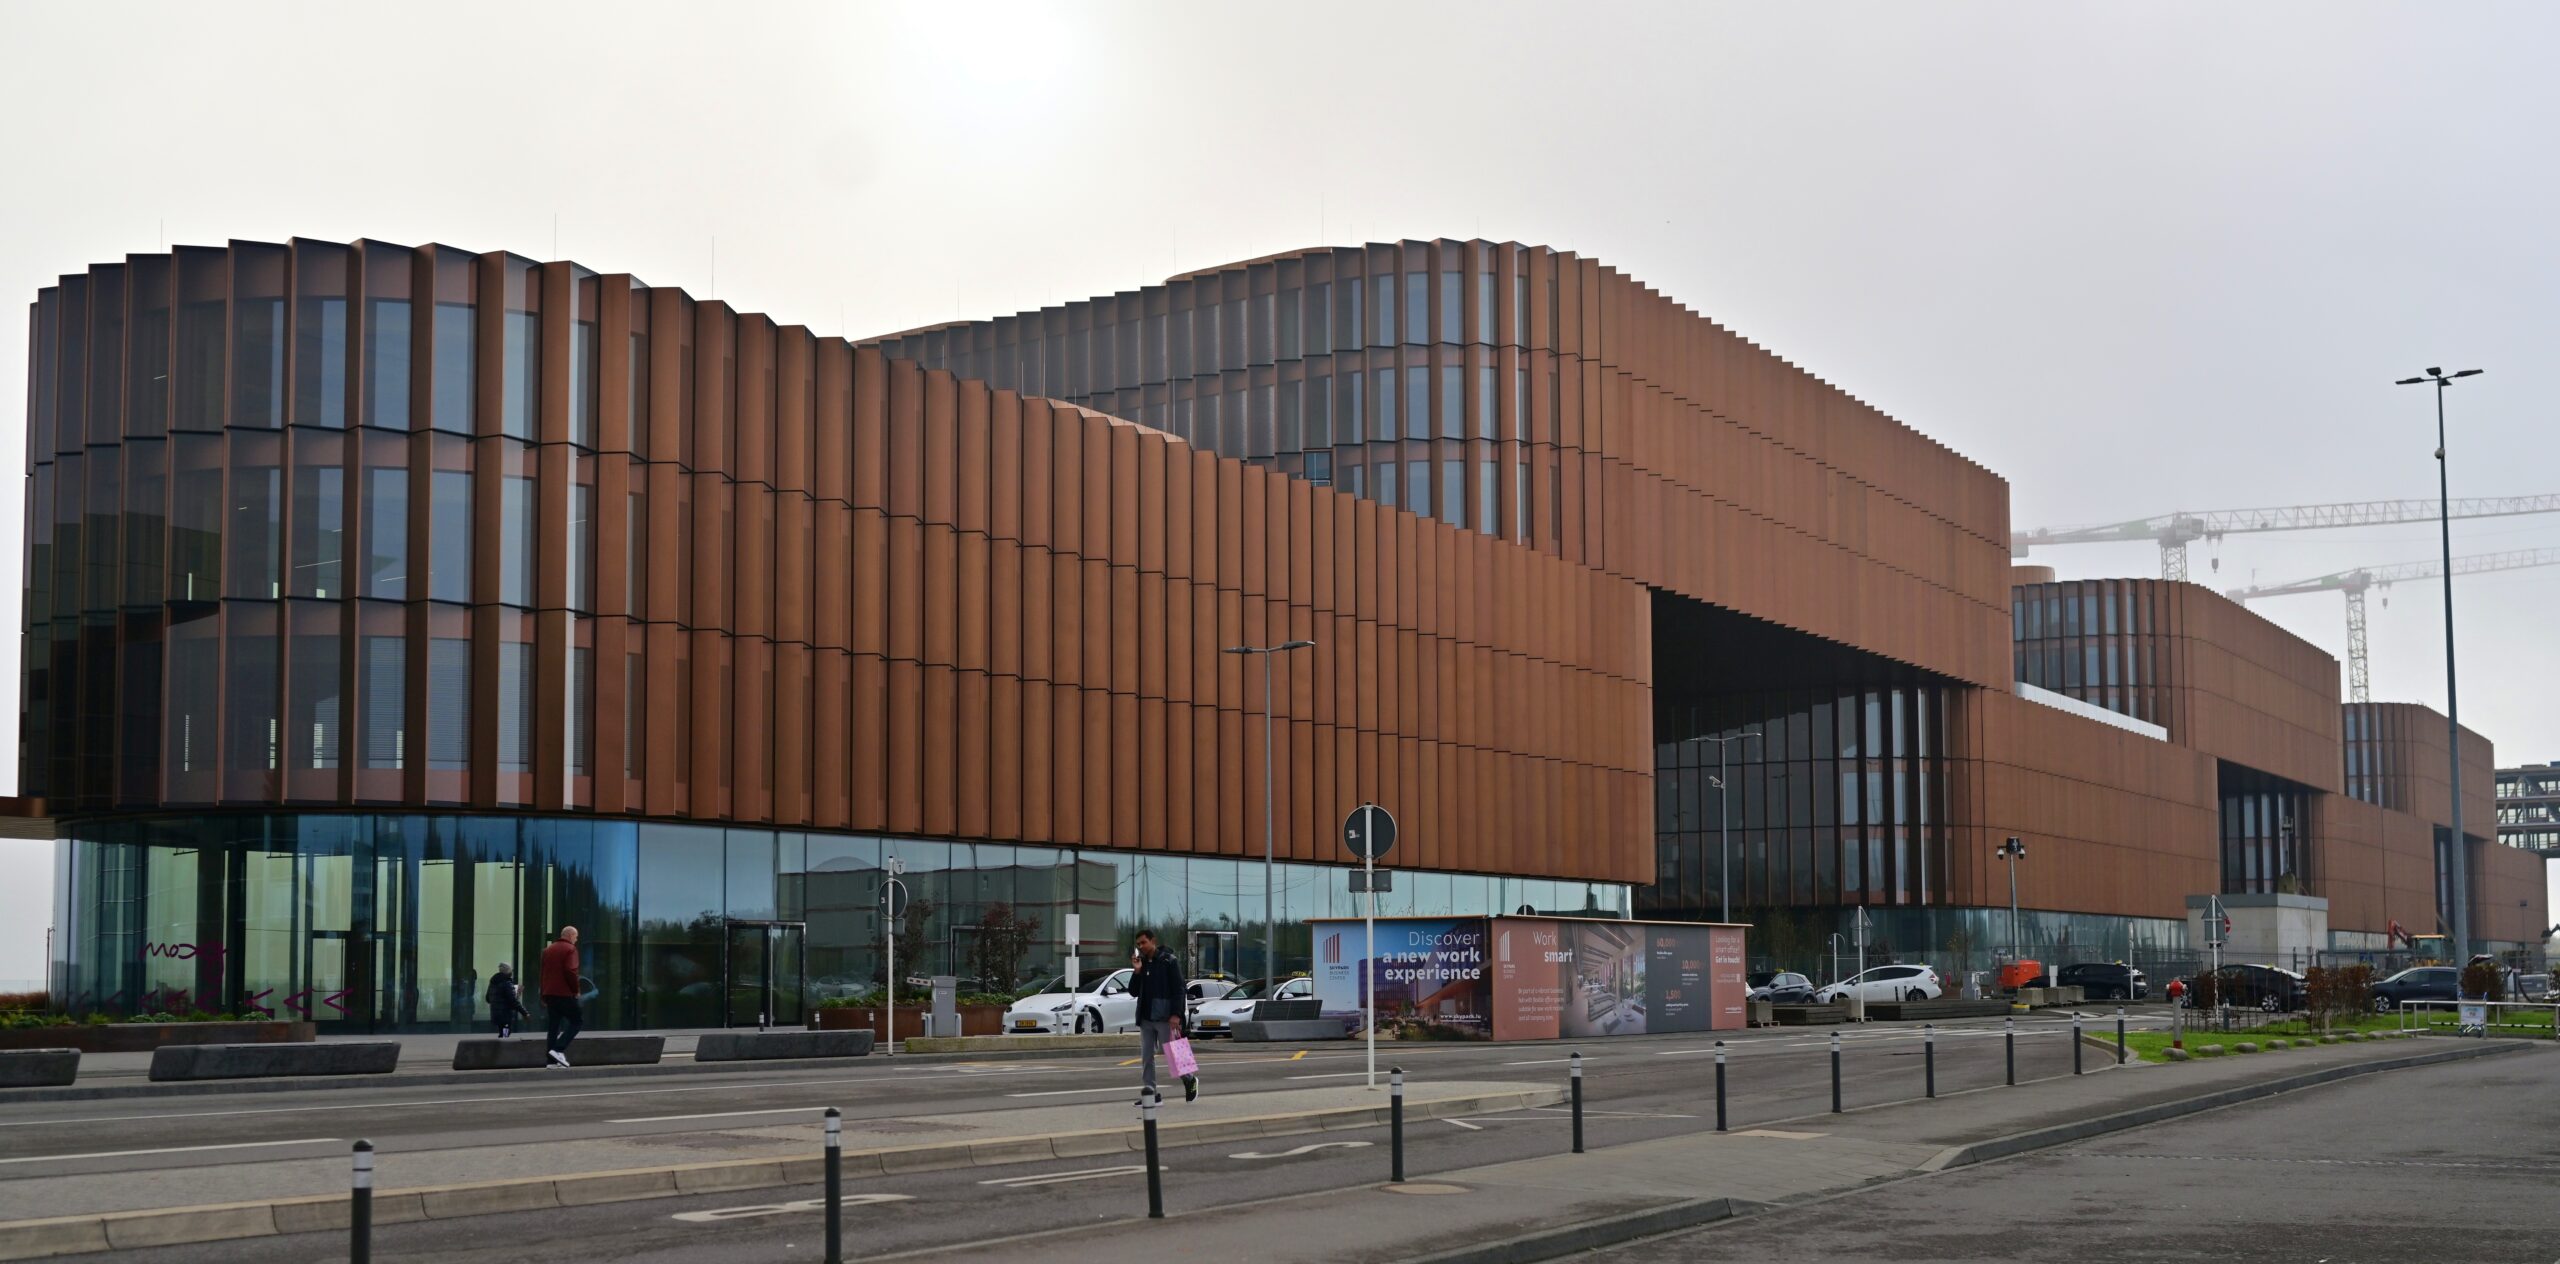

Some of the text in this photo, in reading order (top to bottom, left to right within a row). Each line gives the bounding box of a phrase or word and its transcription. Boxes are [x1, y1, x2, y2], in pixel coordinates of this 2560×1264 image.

[1409, 931, 1480, 946] Discover
[1533, 931, 1557, 946] Work
[1383, 947, 1481, 963] a new work
[1544, 949, 1574, 963] smart
[1385, 964, 1481, 984] experience
